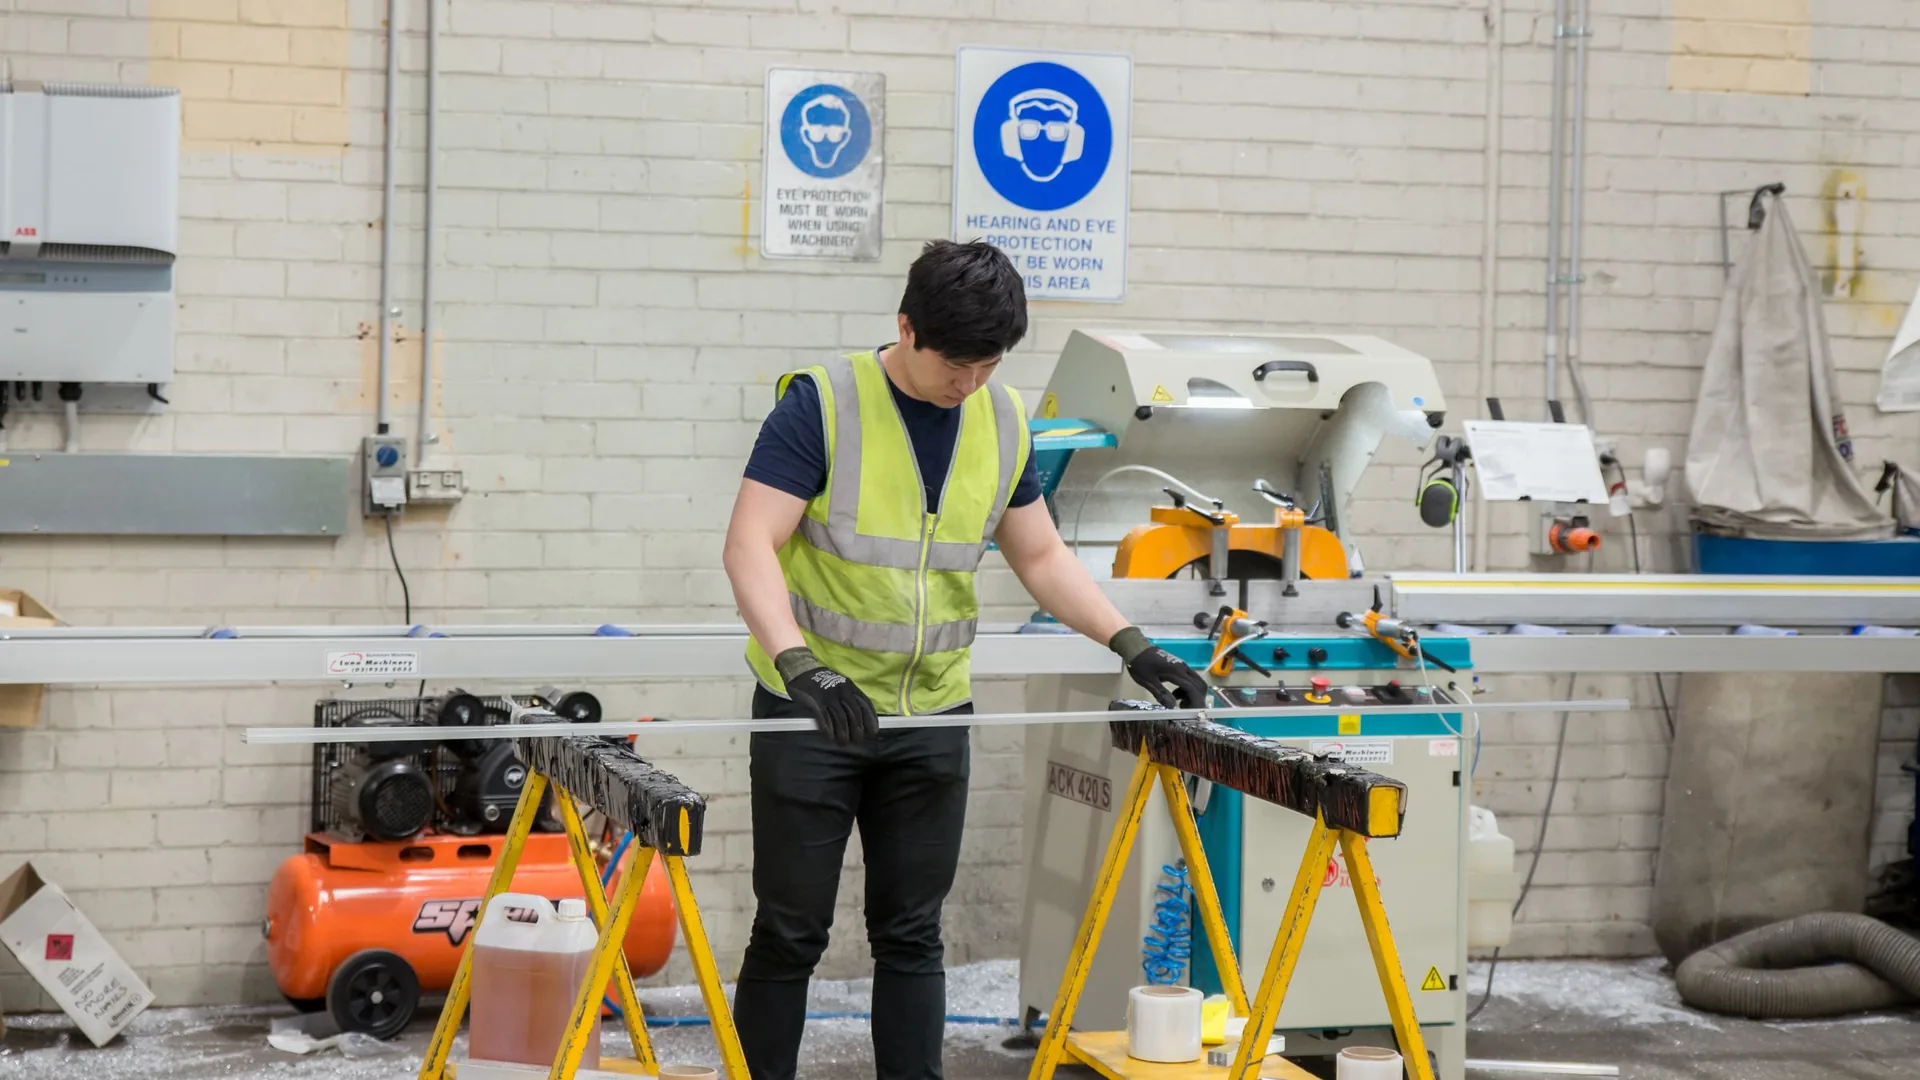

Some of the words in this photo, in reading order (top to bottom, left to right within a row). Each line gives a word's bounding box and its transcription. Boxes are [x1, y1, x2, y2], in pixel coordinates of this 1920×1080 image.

[776, 188, 796, 200] EYE
[803, 189, 871, 203] PROTECTION
[780, 204, 811, 216] MUST
[816, 205, 828, 217] BE
[835, 206, 868, 218] WORN
[788, 220, 821, 231] WHEN
[826, 221, 860, 232] USING
[966, 215, 1041, 230] HEARING
[1046, 217, 1080, 232] AND
[1086, 219, 1117, 233] EYE
[15, 227, 37, 237] ABB
[790, 234, 855, 247] MACHINERY
[987, 235, 1093, 252] PROTECTION
[1027, 256, 1047, 269] BE
[1053, 257, 1103, 271] WORN
[1023, 275, 1042, 289] IS
[1047, 276, 1091, 290] AREA
[1049, 766, 1075, 797] ACK
[1078, 774, 1099, 804] 420
[1103, 782, 1110, 808] S
[74, 989, 94, 1009] NO
[84, 977, 121, 1013] MORE
